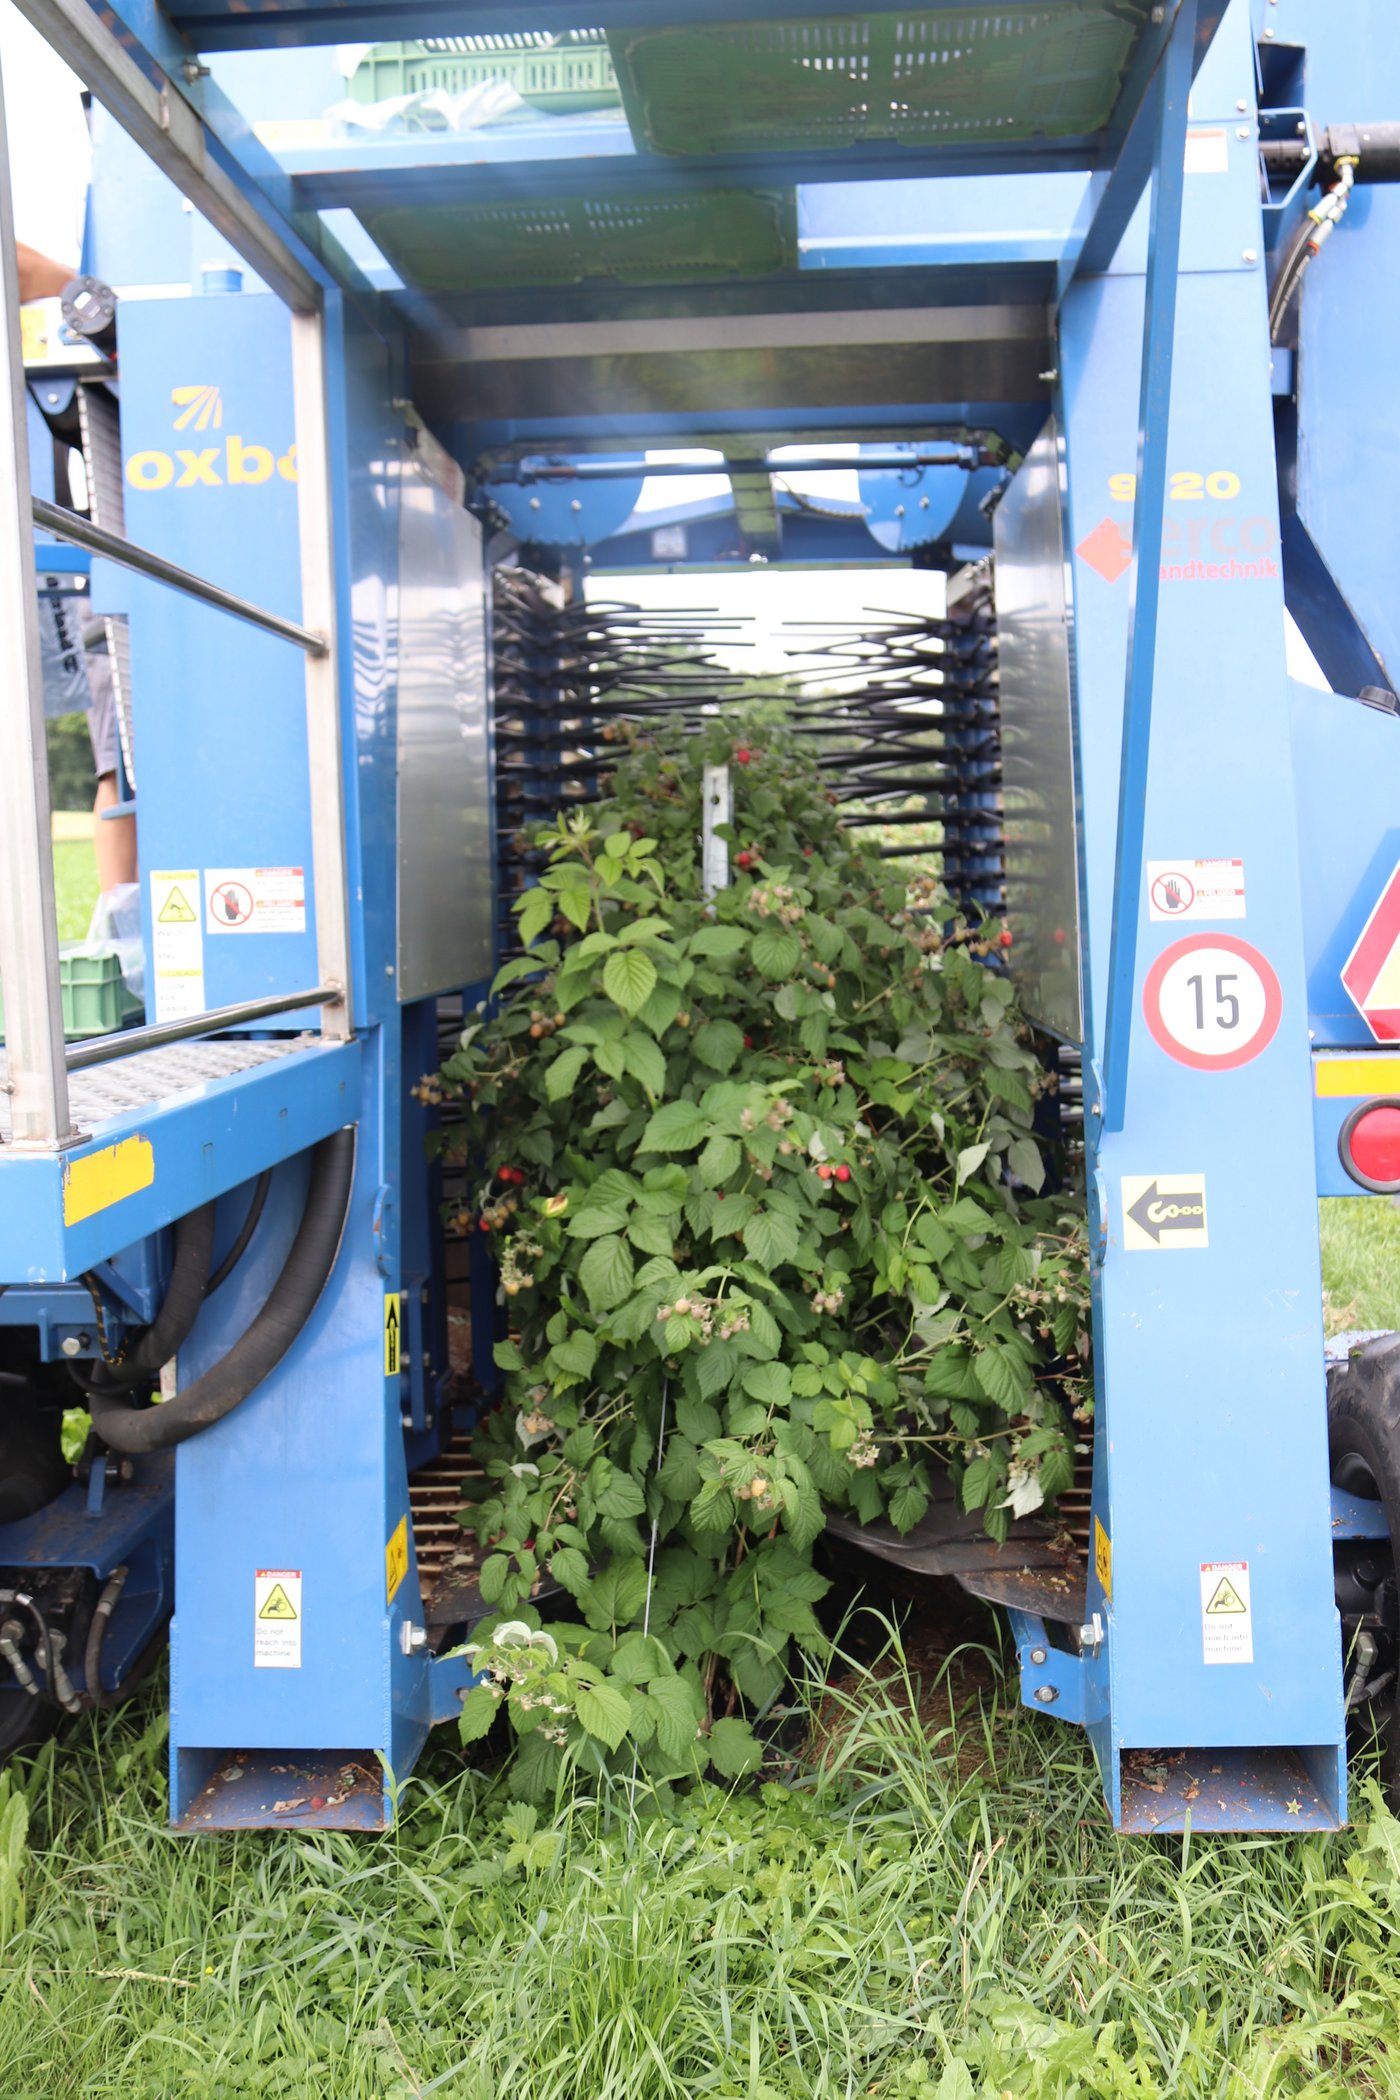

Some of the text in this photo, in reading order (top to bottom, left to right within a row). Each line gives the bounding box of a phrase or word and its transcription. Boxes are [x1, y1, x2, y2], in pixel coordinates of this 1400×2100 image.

[1187, 974, 1240, 1030] 15
[1211, 1563, 1243, 1571] DANGER
[266, 1570, 297, 1578] DANGER
[256, 1627, 284, 1635] Do not
[1204, 1623, 1233, 1631] Do not
[1232, 1633, 1249, 1641] into
[255, 1638, 298, 1646] reach into
[255, 1649, 292, 1657] machine
[1205, 1645, 1243, 1653] machine
